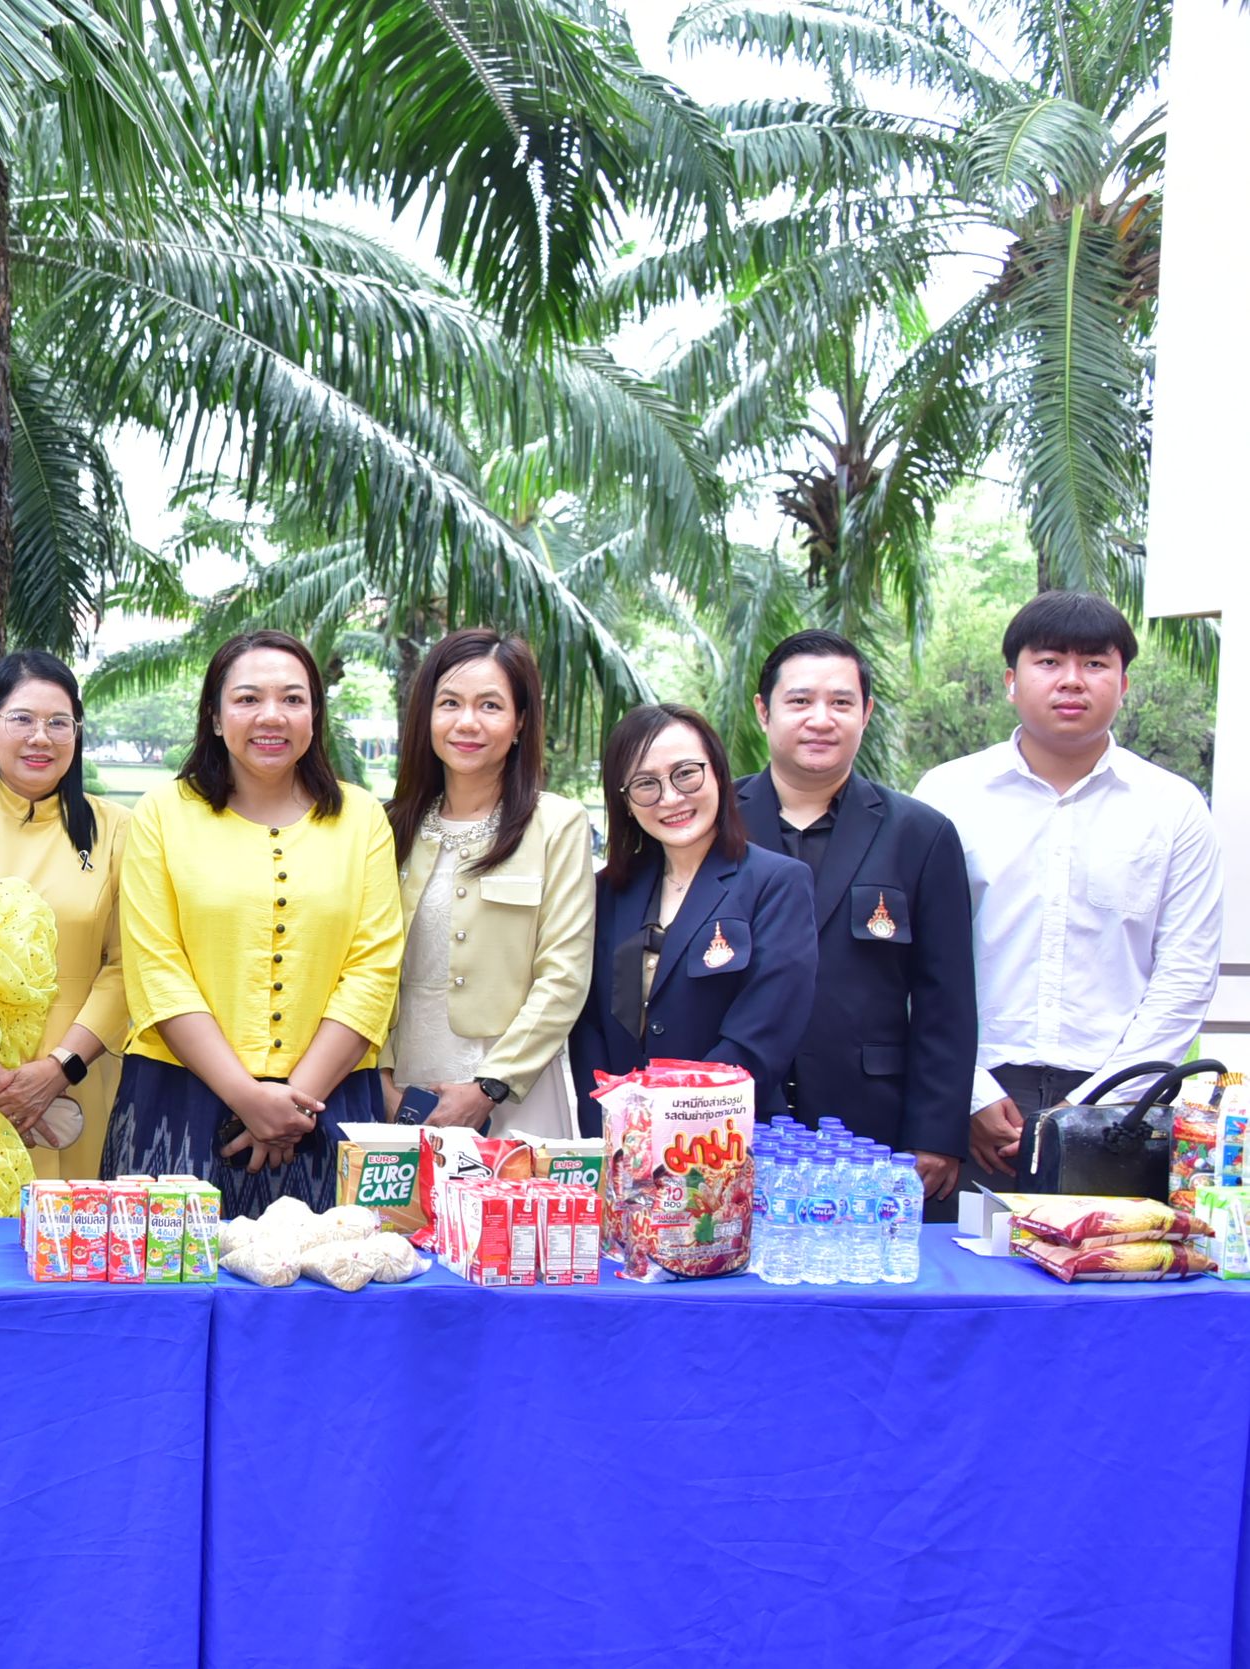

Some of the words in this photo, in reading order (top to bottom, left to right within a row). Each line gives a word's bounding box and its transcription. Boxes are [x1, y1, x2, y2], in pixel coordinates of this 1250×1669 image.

[672, 1094, 743, 1109] บะหมี่กึ่งสำเร็จรูป
[663, 1118, 745, 1174] มาม่า
[368, 1155, 400, 1164] EURO
[553, 1160, 583, 1170] EURO
[361, 1163, 417, 1185] EURO
[358, 1181, 412, 1203] CAKE
[665, 1187, 685, 1202] 10
[663, 1201, 682, 1209] ซอง
